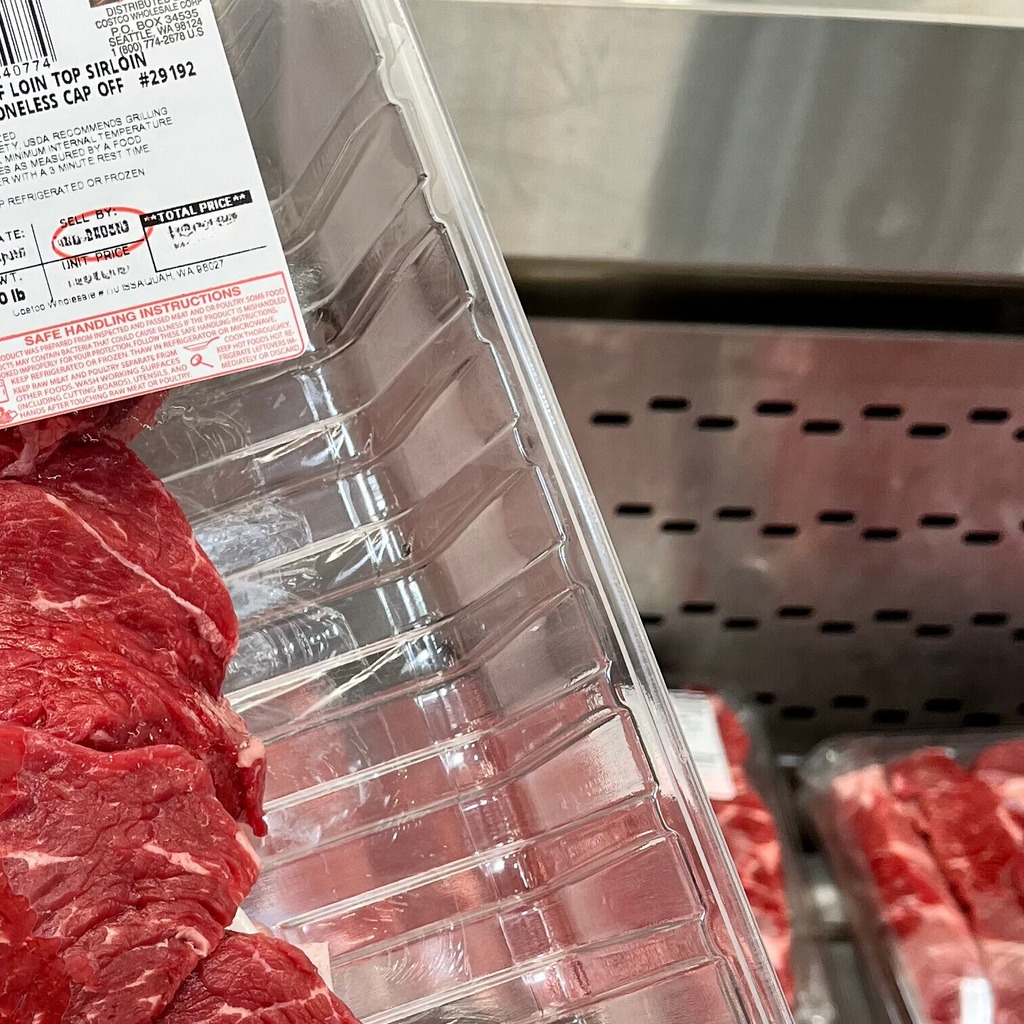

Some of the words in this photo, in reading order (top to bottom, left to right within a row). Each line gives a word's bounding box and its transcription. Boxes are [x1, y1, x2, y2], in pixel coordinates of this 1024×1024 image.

[95, 14, 129, 29] COSTCO
[130, 3, 179, 20] WHOLESALE
[109, 29, 155, 47] SEATTLE,
[157, 24, 174, 35] WA
[174, 17, 203, 31] 98124
[111, 24, 133, 36] P.O.
[136, 17, 163, 31] BOX
[164, 9, 199, 24] 34535
[119, 42, 142, 56] (800)
[143, 32, 186, 49] 774-2678
[10, 75, 48, 97] LOIN
[51, 67, 80, 87] TOP
[86, 52, 147, 79] SIRLOIN
[63, 86, 91, 105] CAP
[98, 77, 124, 97] OFF
[139, 61, 197, 88] #29192
[4, 146, 45, 162] MINIMUM
[49, 136, 97, 151] INTERNAL
[98, 117, 172, 139] TEMPERATURE
[24, 135, 50, 147] USDA
[52, 118, 122, 140] RECOMMENDS
[126, 107, 168, 123] GRILLING
[11, 171, 37, 183] WITH
[49, 166, 55, 174] 3
[58, 157, 95, 172] MINUTE
[97, 150, 121, 162] REST
[126, 144, 149, 155] TIME
[15, 162, 27, 172] AS
[30, 148, 85, 168] MEASURED
[87, 144, 100, 154] BY
[113, 135, 141, 148] FOOD
[8, 181, 84, 205] REFRIGERATED
[87, 177, 103, 187] OR
[104, 169, 145, 182] FROZEN
[60, 214, 90, 228] SELL
[95, 207, 117, 220] BY:
[62, 256, 87, 270] UNIT
[95, 246, 130, 262] PRICE
[176, 267, 195, 277] WA
[11, 288, 26, 303] lb
[24, 329, 62, 346] SAFE
[64, 312, 137, 337] HANDLING
[139, 287, 241, 319] INSTRUCTIONS
